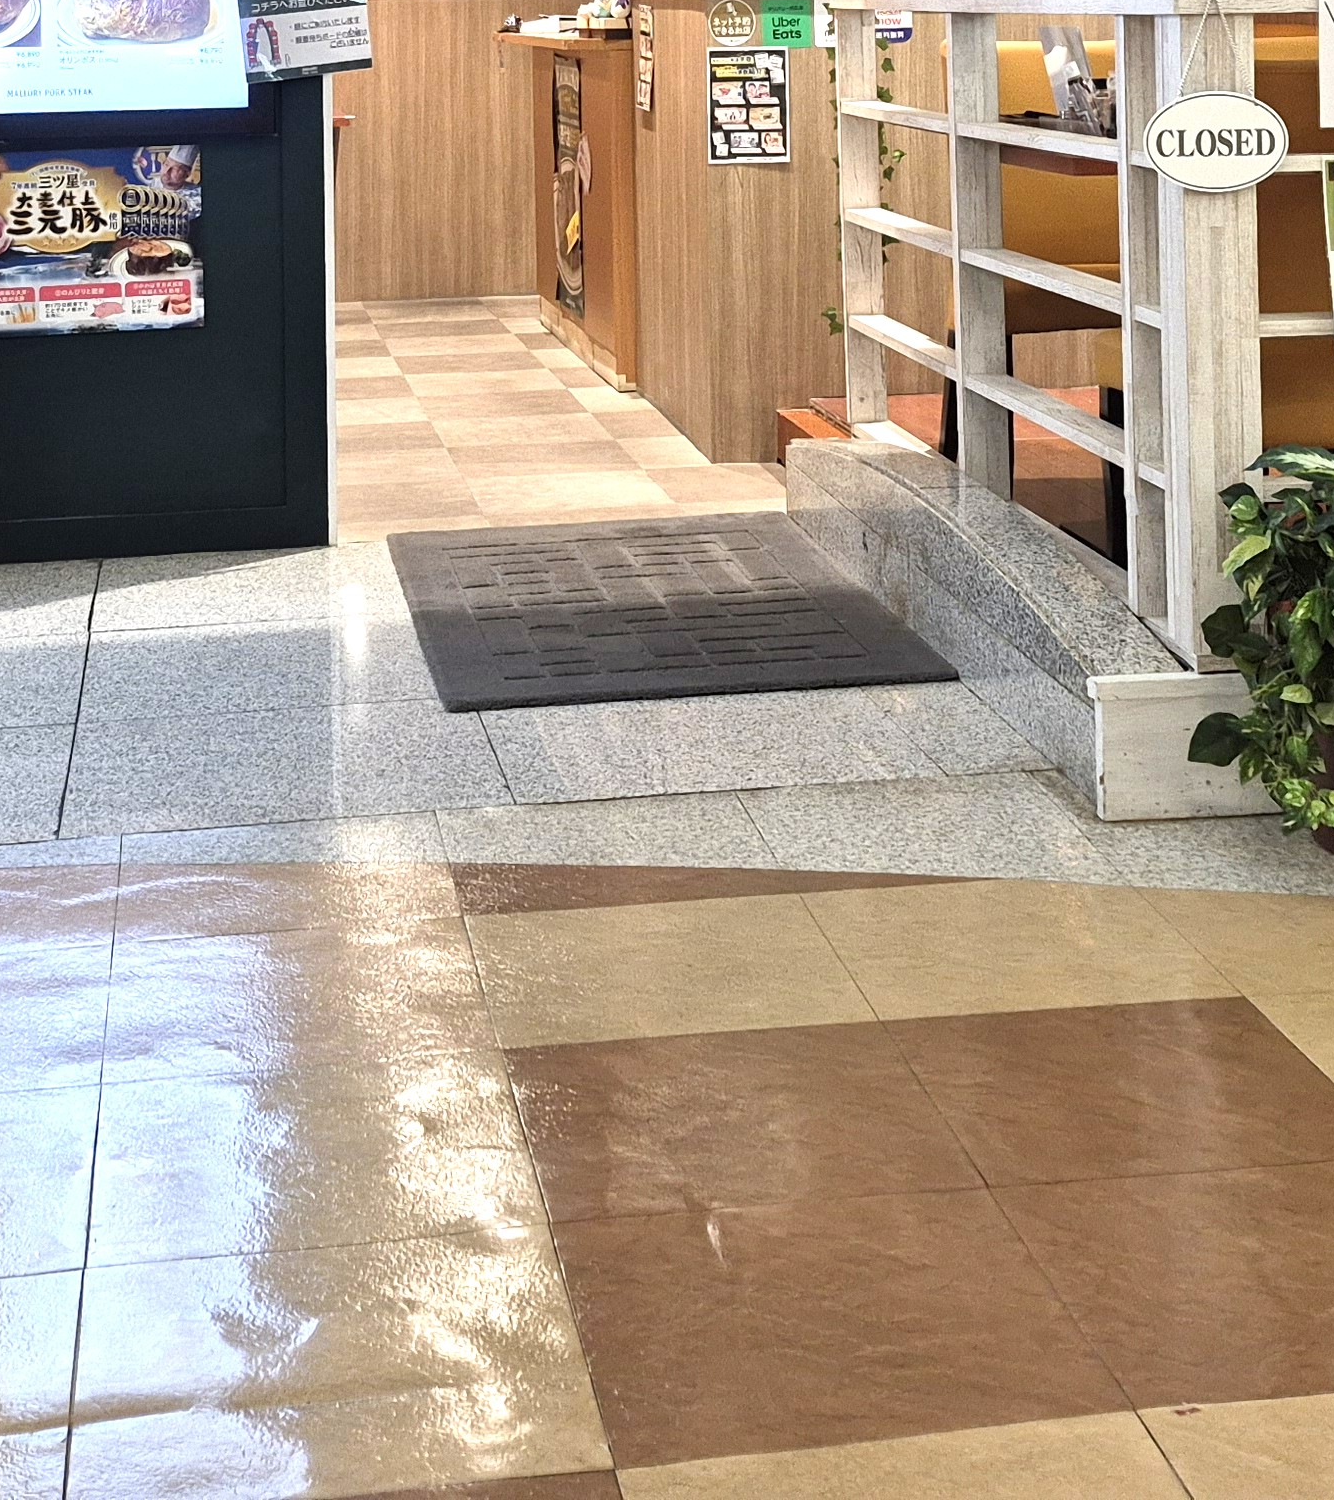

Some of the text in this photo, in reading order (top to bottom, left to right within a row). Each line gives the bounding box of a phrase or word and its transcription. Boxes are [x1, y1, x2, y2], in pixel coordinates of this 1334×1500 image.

[771, 16, 801, 28] Uber
[772, 28, 802, 40] Eats
[1155, 127, 1276, 159] CLOSED
[15, 190, 96, 210] 大麦仕上
[7, 207, 107, 235] 三元豚
